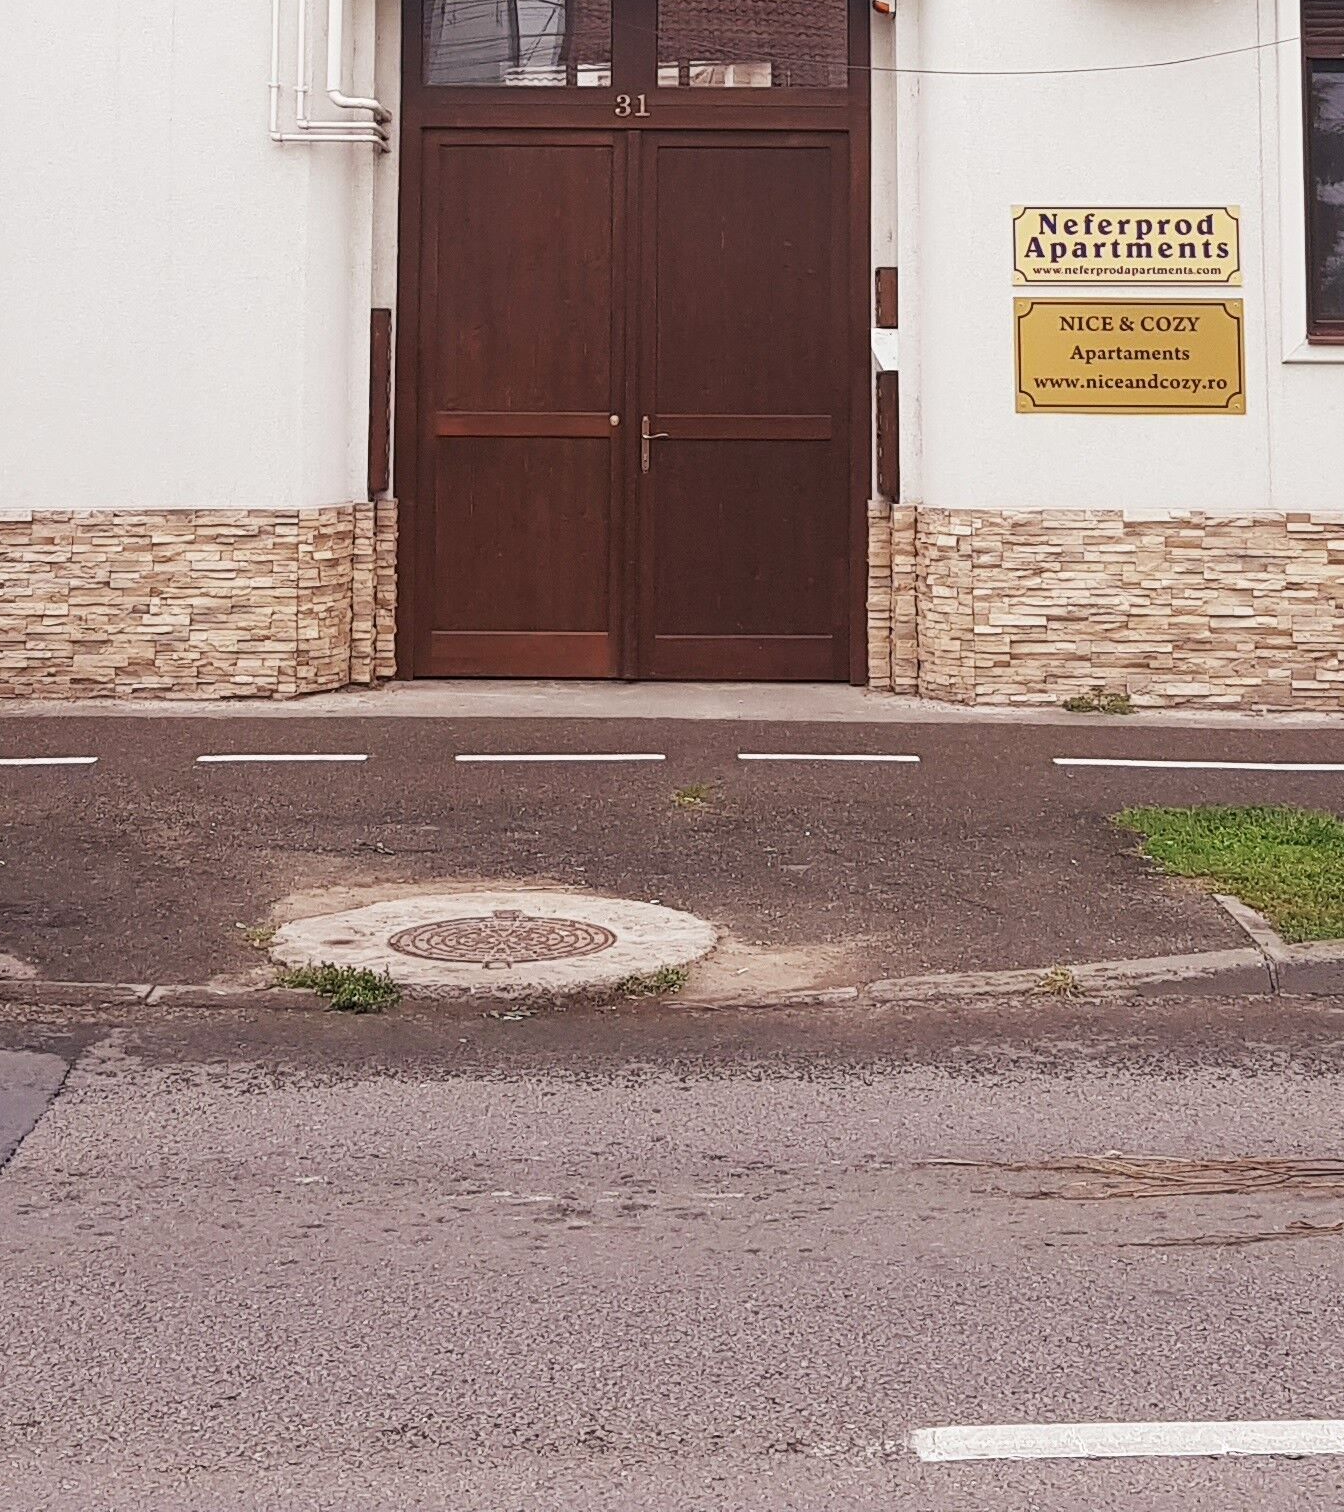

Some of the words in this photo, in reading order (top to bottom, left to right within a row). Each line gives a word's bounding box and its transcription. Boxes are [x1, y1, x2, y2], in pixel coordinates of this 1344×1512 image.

[615, 94, 651, 117] 31
[1038, 213, 1214, 240] Neferprod
[1024, 236, 1230, 263] Apartments
[1032, 265, 1222, 277] www.neferprodapartments.com
[1059, 316, 1114, 332] NICE
[1119, 316, 1135, 332] &
[1140, 316, 1201, 332] COZY
[1069, 345, 1191, 364] Apartaments
[1034, 374, 1228, 394] www.niceandcozy.ro
